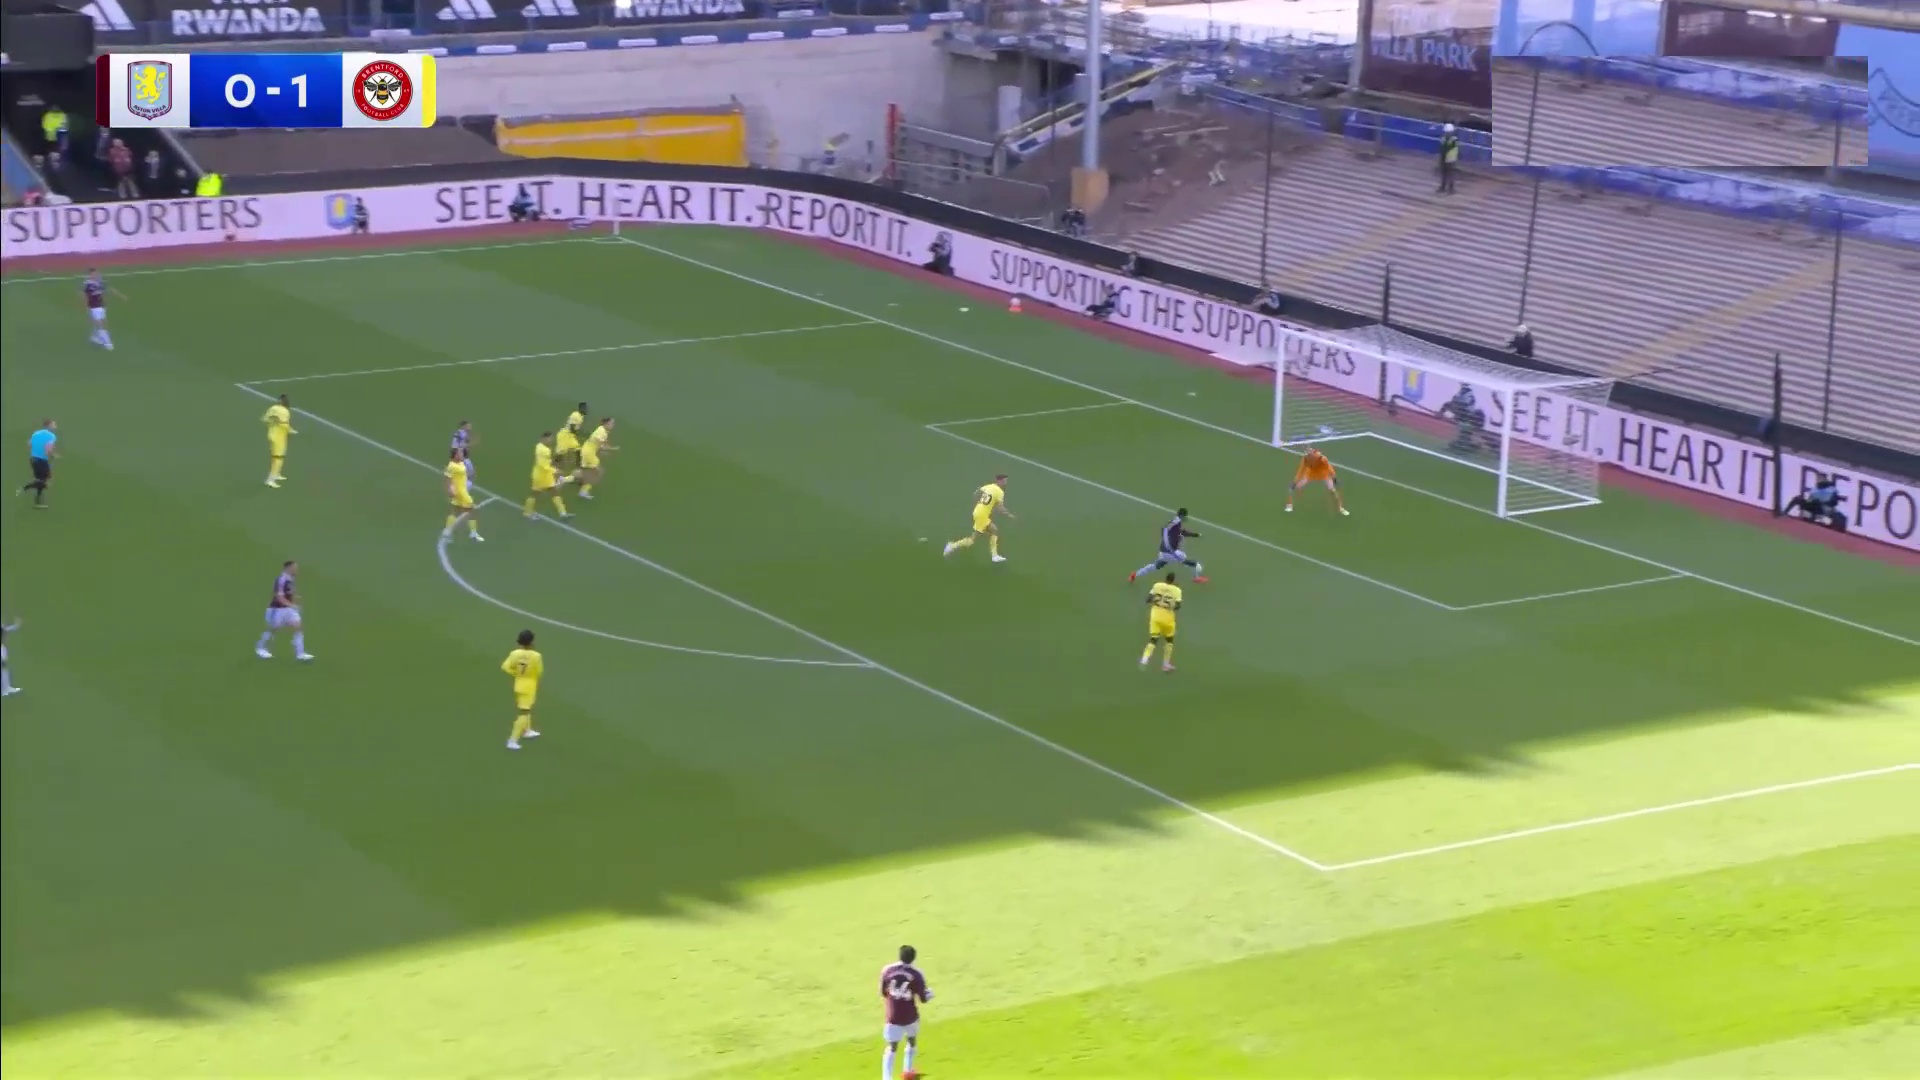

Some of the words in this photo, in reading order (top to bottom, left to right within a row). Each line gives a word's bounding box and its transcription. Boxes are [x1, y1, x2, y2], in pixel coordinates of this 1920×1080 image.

[171, 6, 326, 35] RWANDA
[1422, 39, 1478, 71] PARK
[8, 197, 262, 243] SUPPORTERS
[435, 184, 504, 223] SEE
[577, 181, 694, 219] HEAR
[708, 187, 752, 223] IT.
[764, 191, 882, 247] REPORT
[886, 219, 912, 258] IT.
[1139, 288, 1186, 333] THE
[1489, 390, 1552, 441] SEE
[1617, 416, 1725, 490] HEAR
